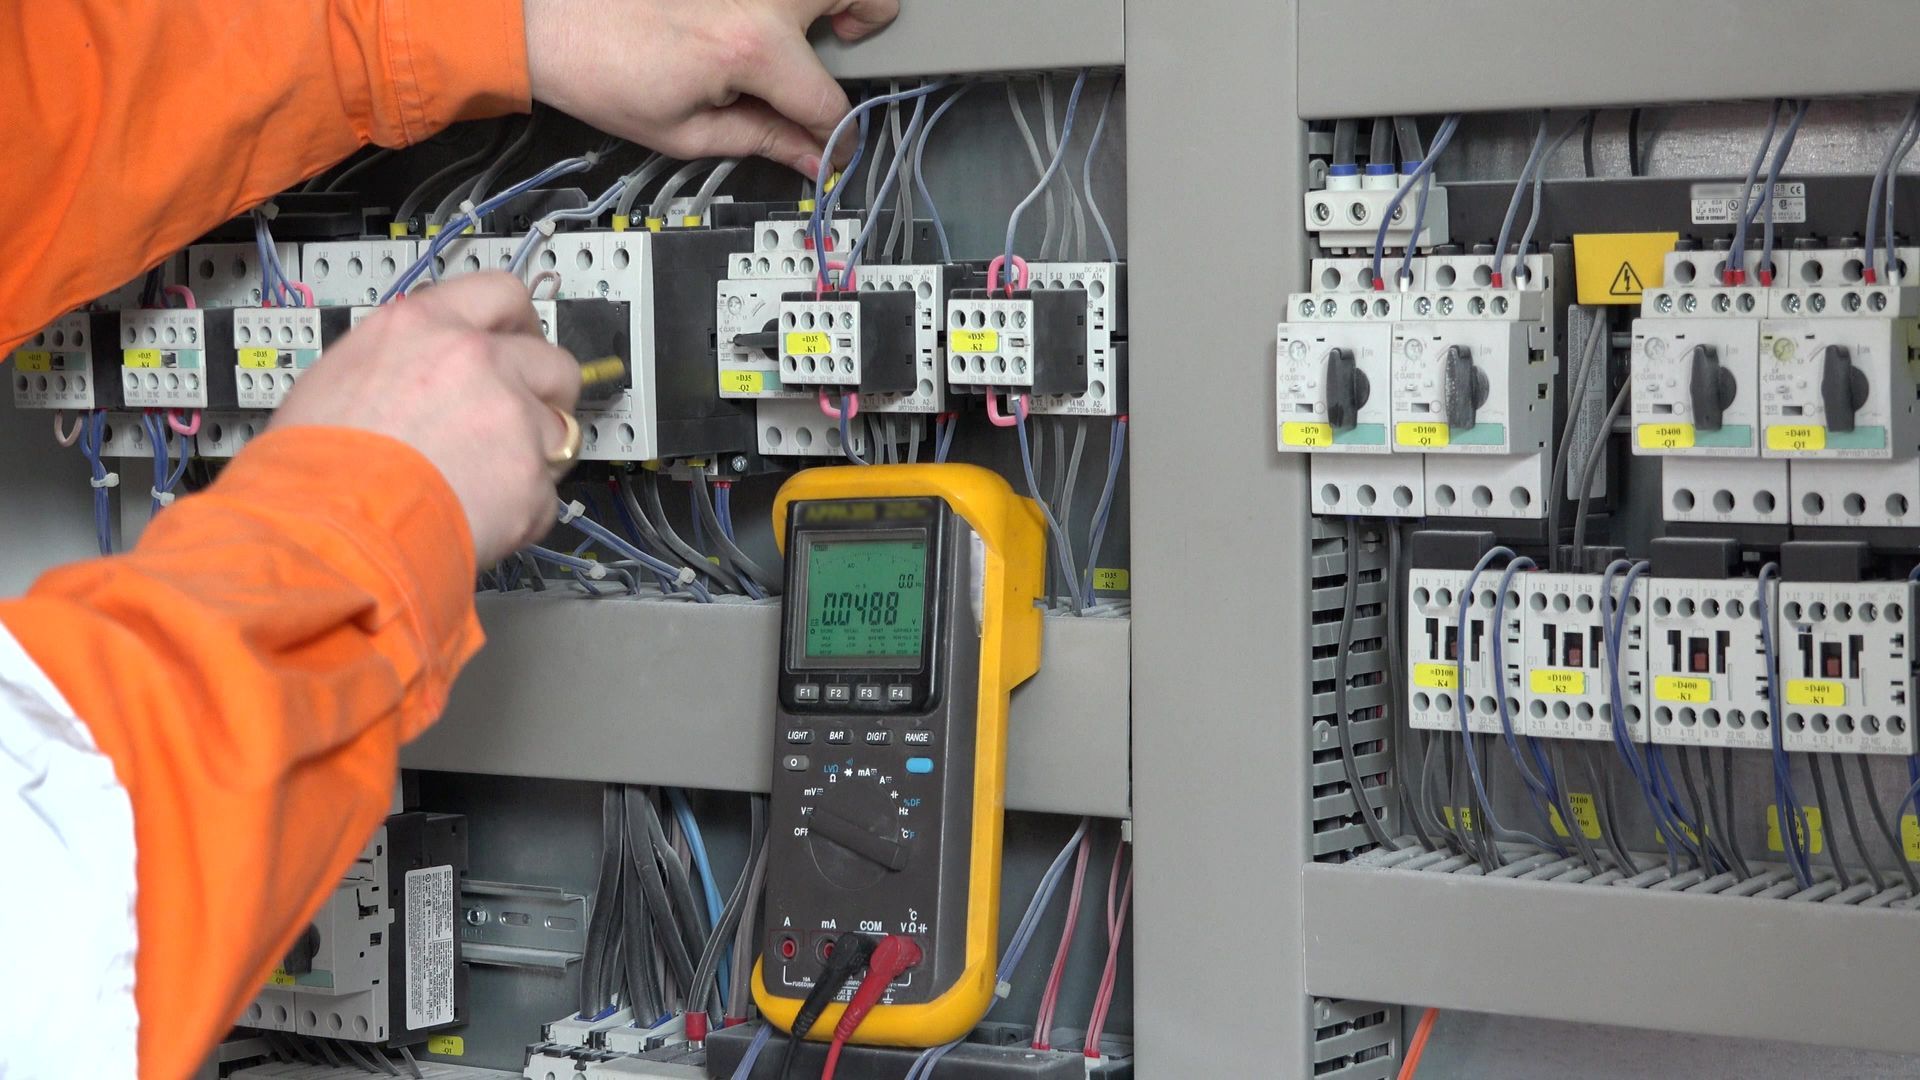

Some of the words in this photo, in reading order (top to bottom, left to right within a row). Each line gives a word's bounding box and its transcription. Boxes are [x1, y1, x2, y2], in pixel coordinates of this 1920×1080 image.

[802, 335, 819, 343] =D35
[967, 333, 985, 341] =D35
[735, 374, 752, 382] =D35
[1300, 426, 1319, 435] =D70
[1412, 426, 1437, 434] =D100
[1655, 427, 1681, 436] =D400
[1784, 428, 1811, 437] =D401
[898, 573, 915, 589] 0.0
[821, 591, 899, 626] 0.0488
[1430, 668, 1454, 677] =D100
[1547, 673, 1572, 682] =D100
[1672, 681, 1698, 690] =D400
[1804, 684, 1831, 693] =D401
[799, 688, 811, 697] F1
[830, 689, 842, 698] F2
[860, 689, 873, 698] F3
[891, 689, 904, 698] F4
[787, 731, 808, 740] LIGHT
[829, 731, 845, 740] BAR
[866, 732, 887, 741] DIGIT
[904, 733, 929, 742] RANGE
[857, 767, 871, 777] mA
[804, 787, 817, 796] mV
[903, 798, 921, 807] %DF
[1569, 796, 1588, 804] D100
[898, 806, 909, 815] Hz
[793, 827, 809, 836] OFF
[783, 916, 791, 927] A
[821, 918, 837, 929] mA
[859, 920, 883, 932] COM
[900, 922, 907, 933] V
